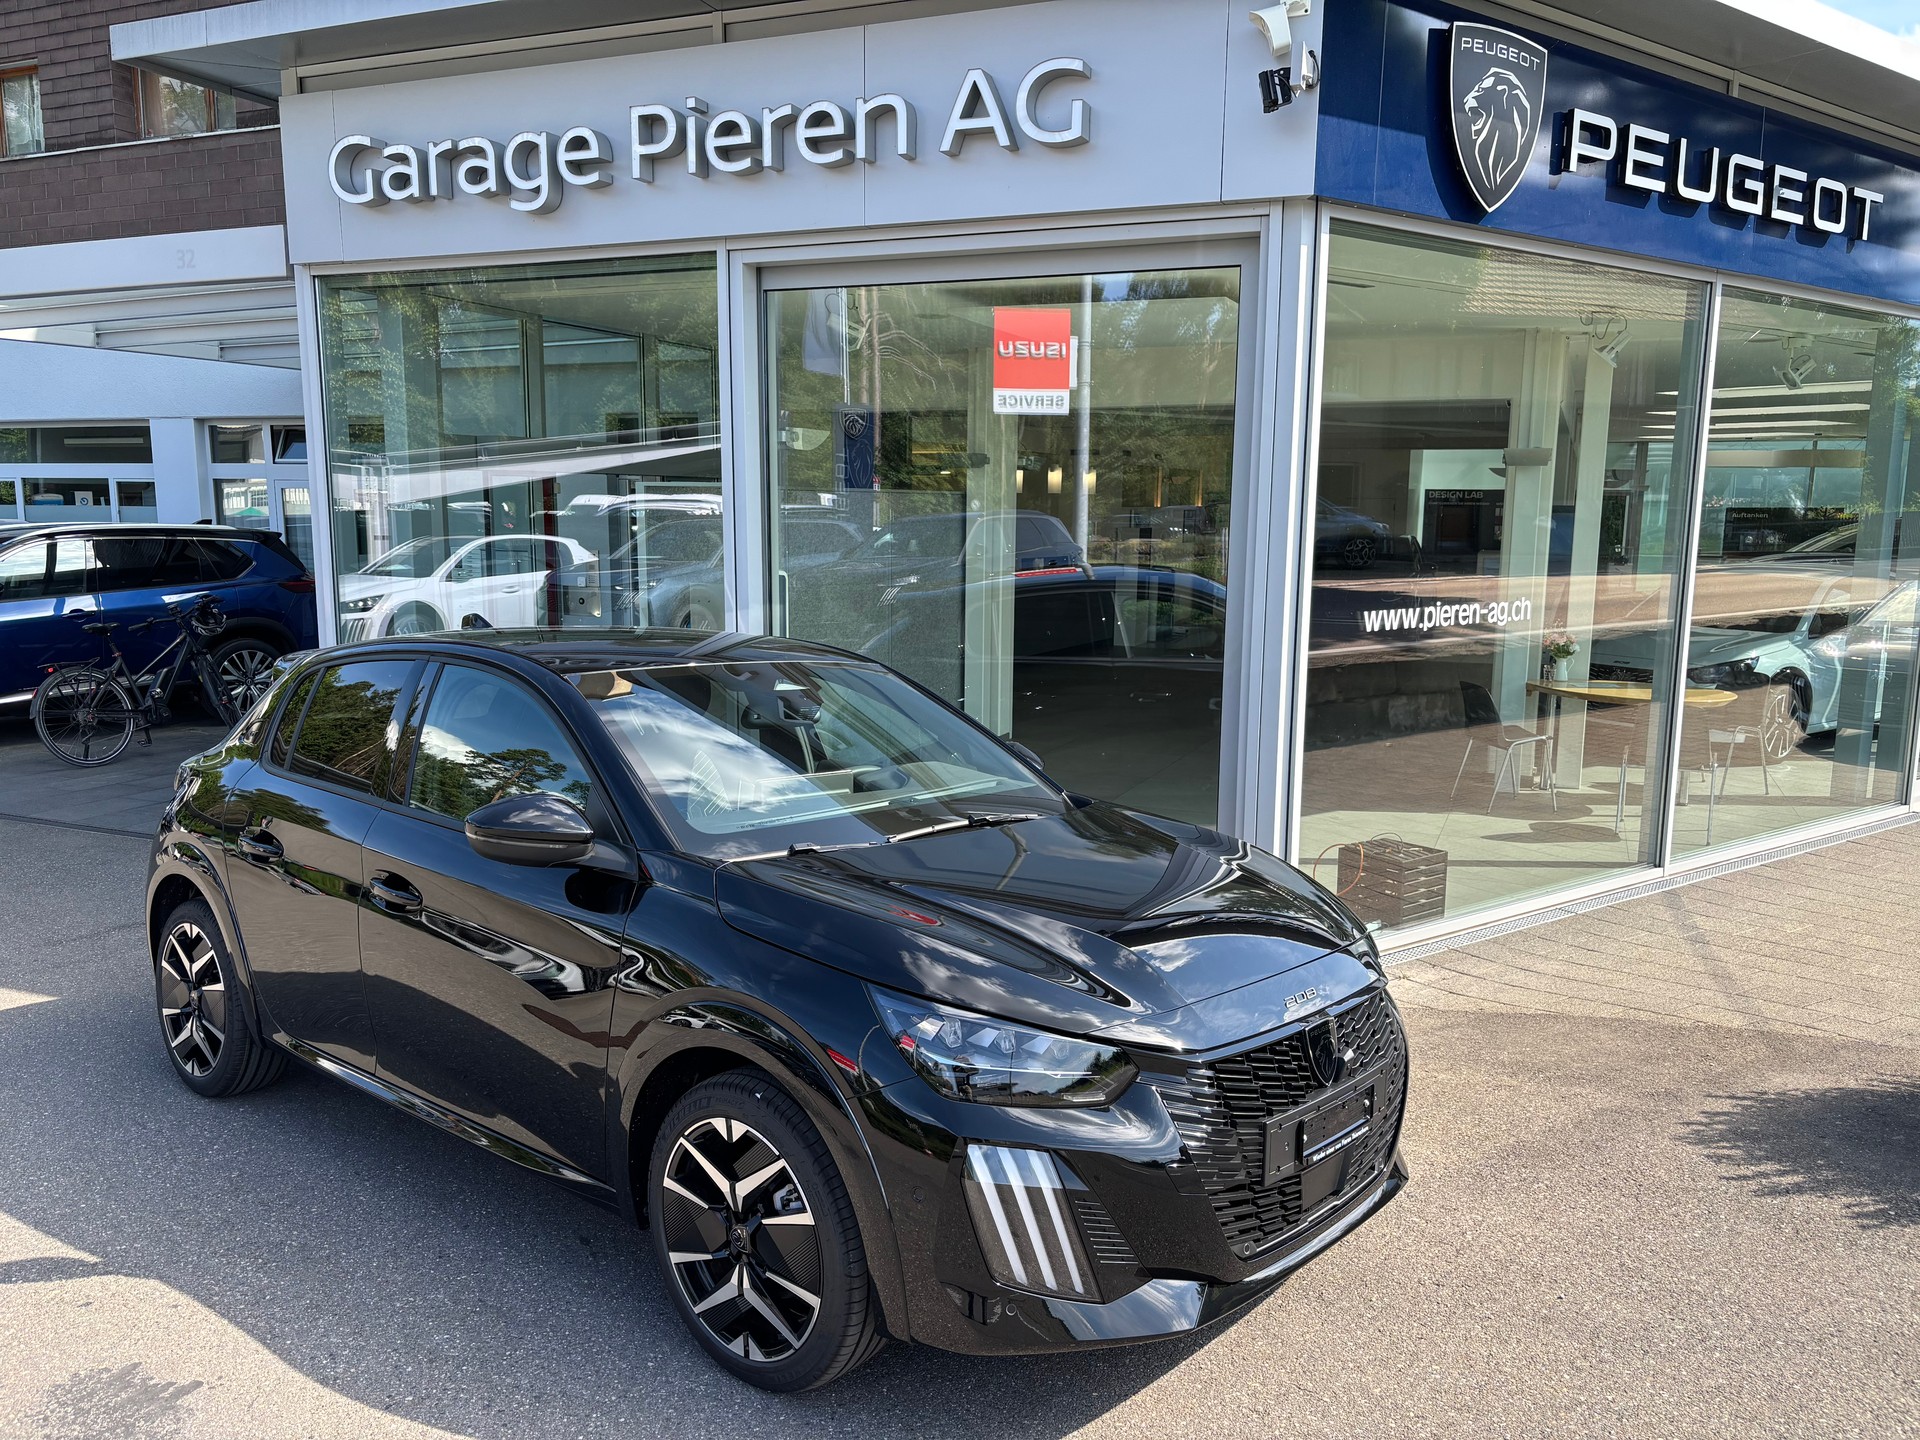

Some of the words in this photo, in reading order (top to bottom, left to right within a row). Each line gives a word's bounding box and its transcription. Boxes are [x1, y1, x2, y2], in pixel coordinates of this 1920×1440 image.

[1461, 36, 1541, 71] PEUGEOT
[328, 125, 613, 215] Garage
[629, 92, 918, 183] Pieren
[938, 57, 1093, 157] AG
[1567, 107, 1885, 241] PEUGEOT
[176, 249, 196, 270] 32
[1428, 490, 1463, 499] DESIGN
[1464, 491, 1484, 499] LAB
[1363, 597, 1532, 633] www.pieren-ag.ch
[1283, 987, 1317, 1009] 208
